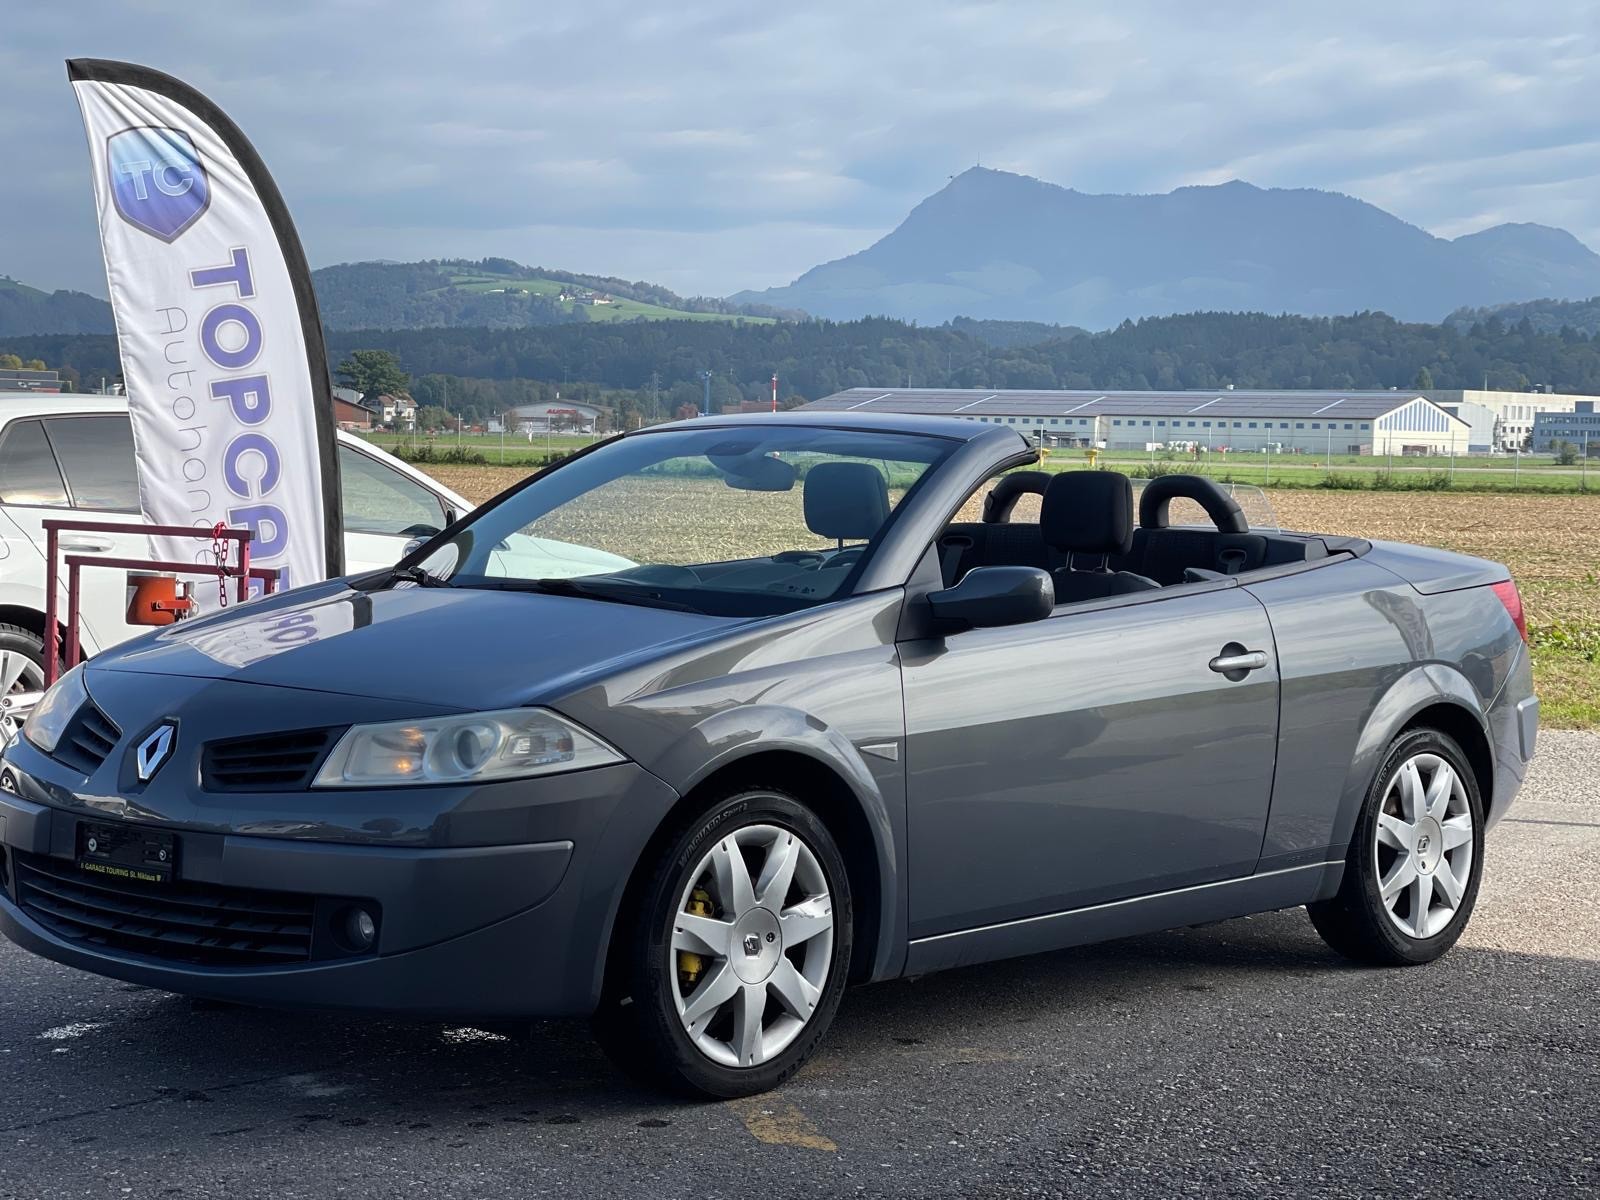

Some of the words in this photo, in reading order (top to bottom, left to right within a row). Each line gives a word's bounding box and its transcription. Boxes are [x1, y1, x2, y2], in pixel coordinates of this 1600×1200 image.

[121, 160, 194, 200] TC
[84, 863, 105, 873] GARAGE
[106, 867, 129, 877] TOURING
